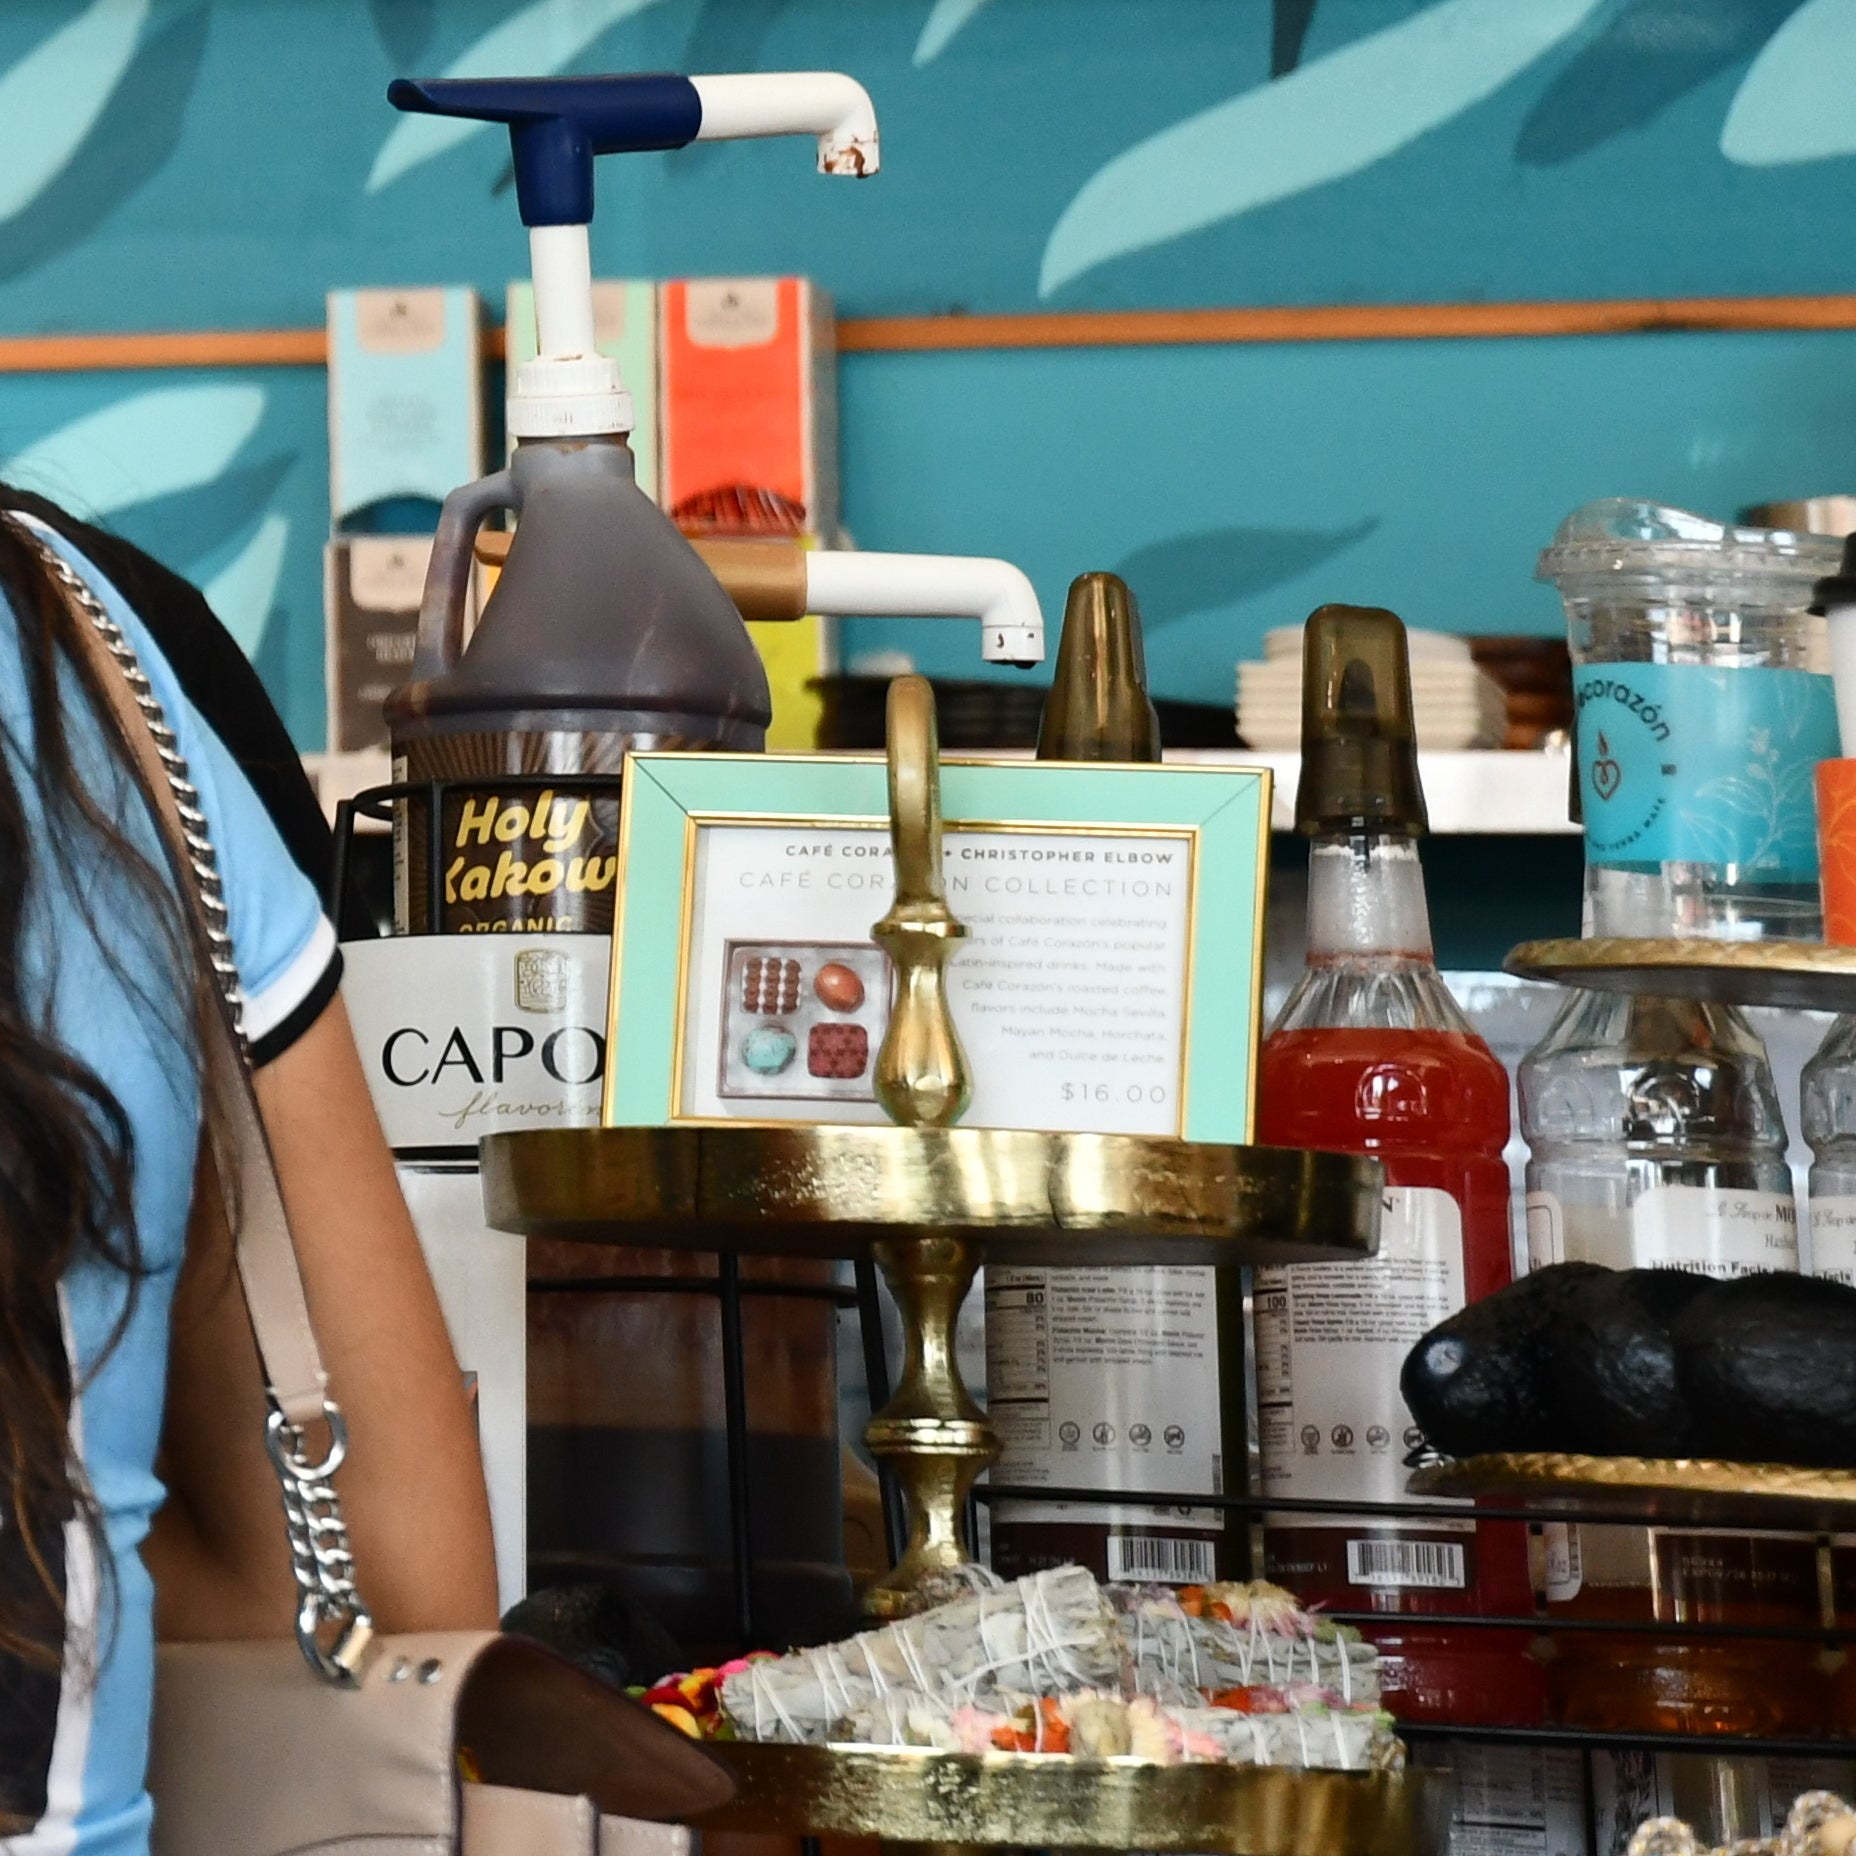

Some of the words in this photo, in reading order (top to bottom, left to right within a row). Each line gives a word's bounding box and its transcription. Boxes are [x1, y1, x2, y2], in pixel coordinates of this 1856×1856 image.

[456, 790, 589, 853] Holy
[785, 843, 833, 858] CAFÉ
[961, 848, 1095, 863] CHRISTOPHER
[1104, 852, 1173, 864] ELBOW
[739, 868, 812, 889] CAFÉ
[985, 876, 1172, 897] COLLECTION
[998, 913, 1086, 926] collaboration
[1091, 916, 1167, 931] celebrating
[1061, 1082, 1167, 1105] $16.00
